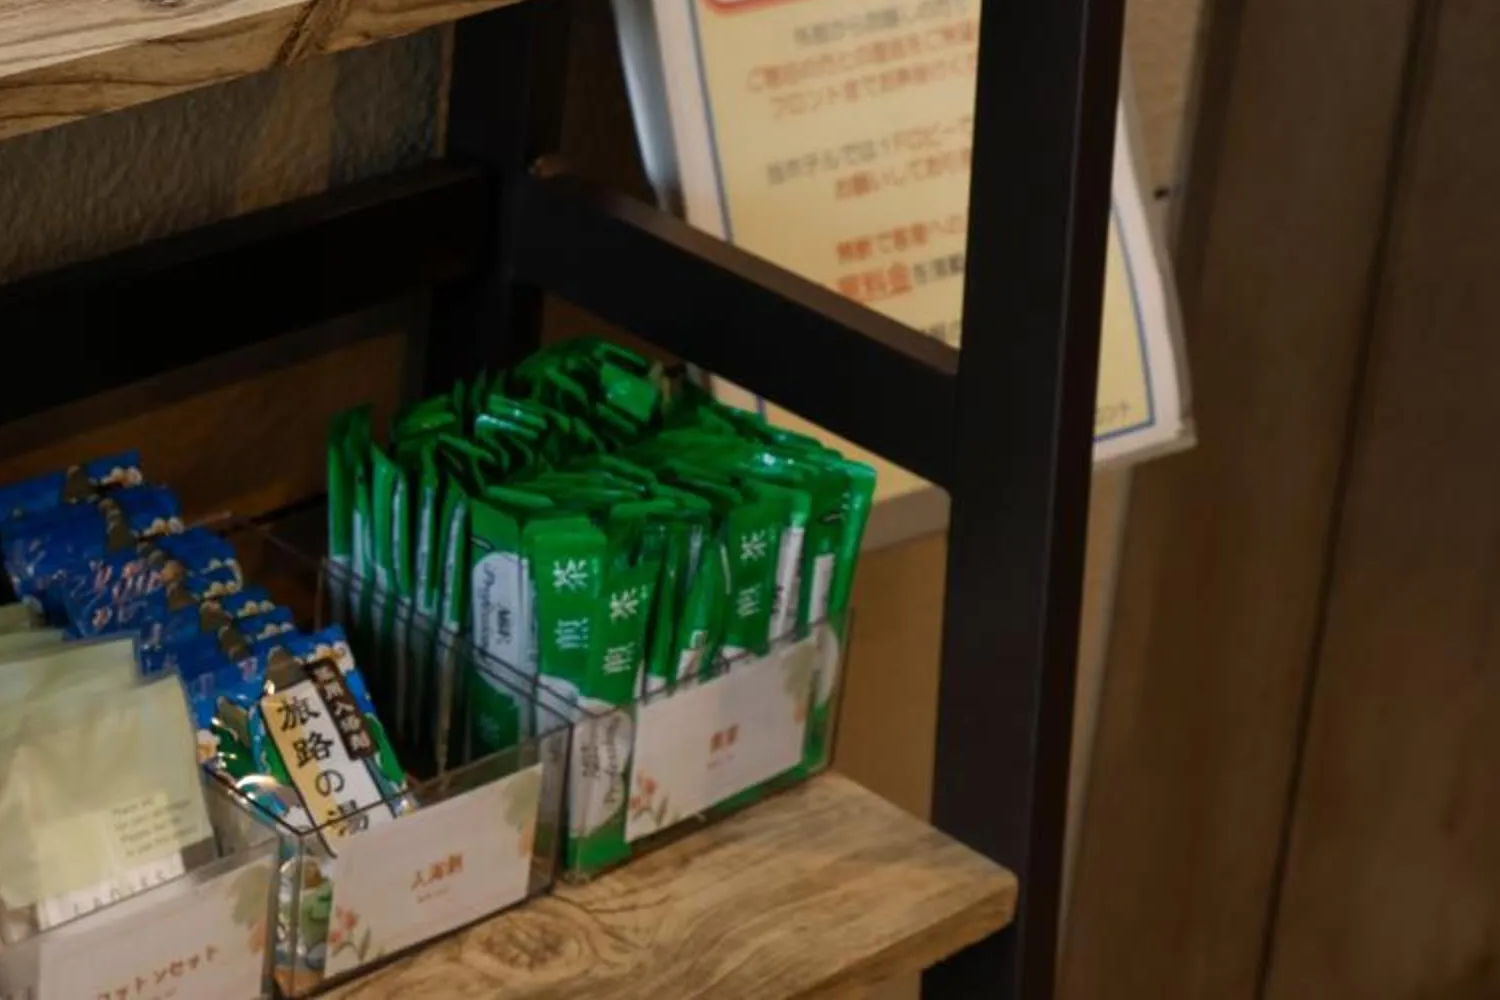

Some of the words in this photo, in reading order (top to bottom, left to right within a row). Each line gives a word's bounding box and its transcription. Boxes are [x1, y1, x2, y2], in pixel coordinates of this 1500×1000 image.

[552, 557, 590, 652] 煎茶
[602, 587, 640, 677] 煎茶
[276, 696, 371, 837] 旅路の湯
